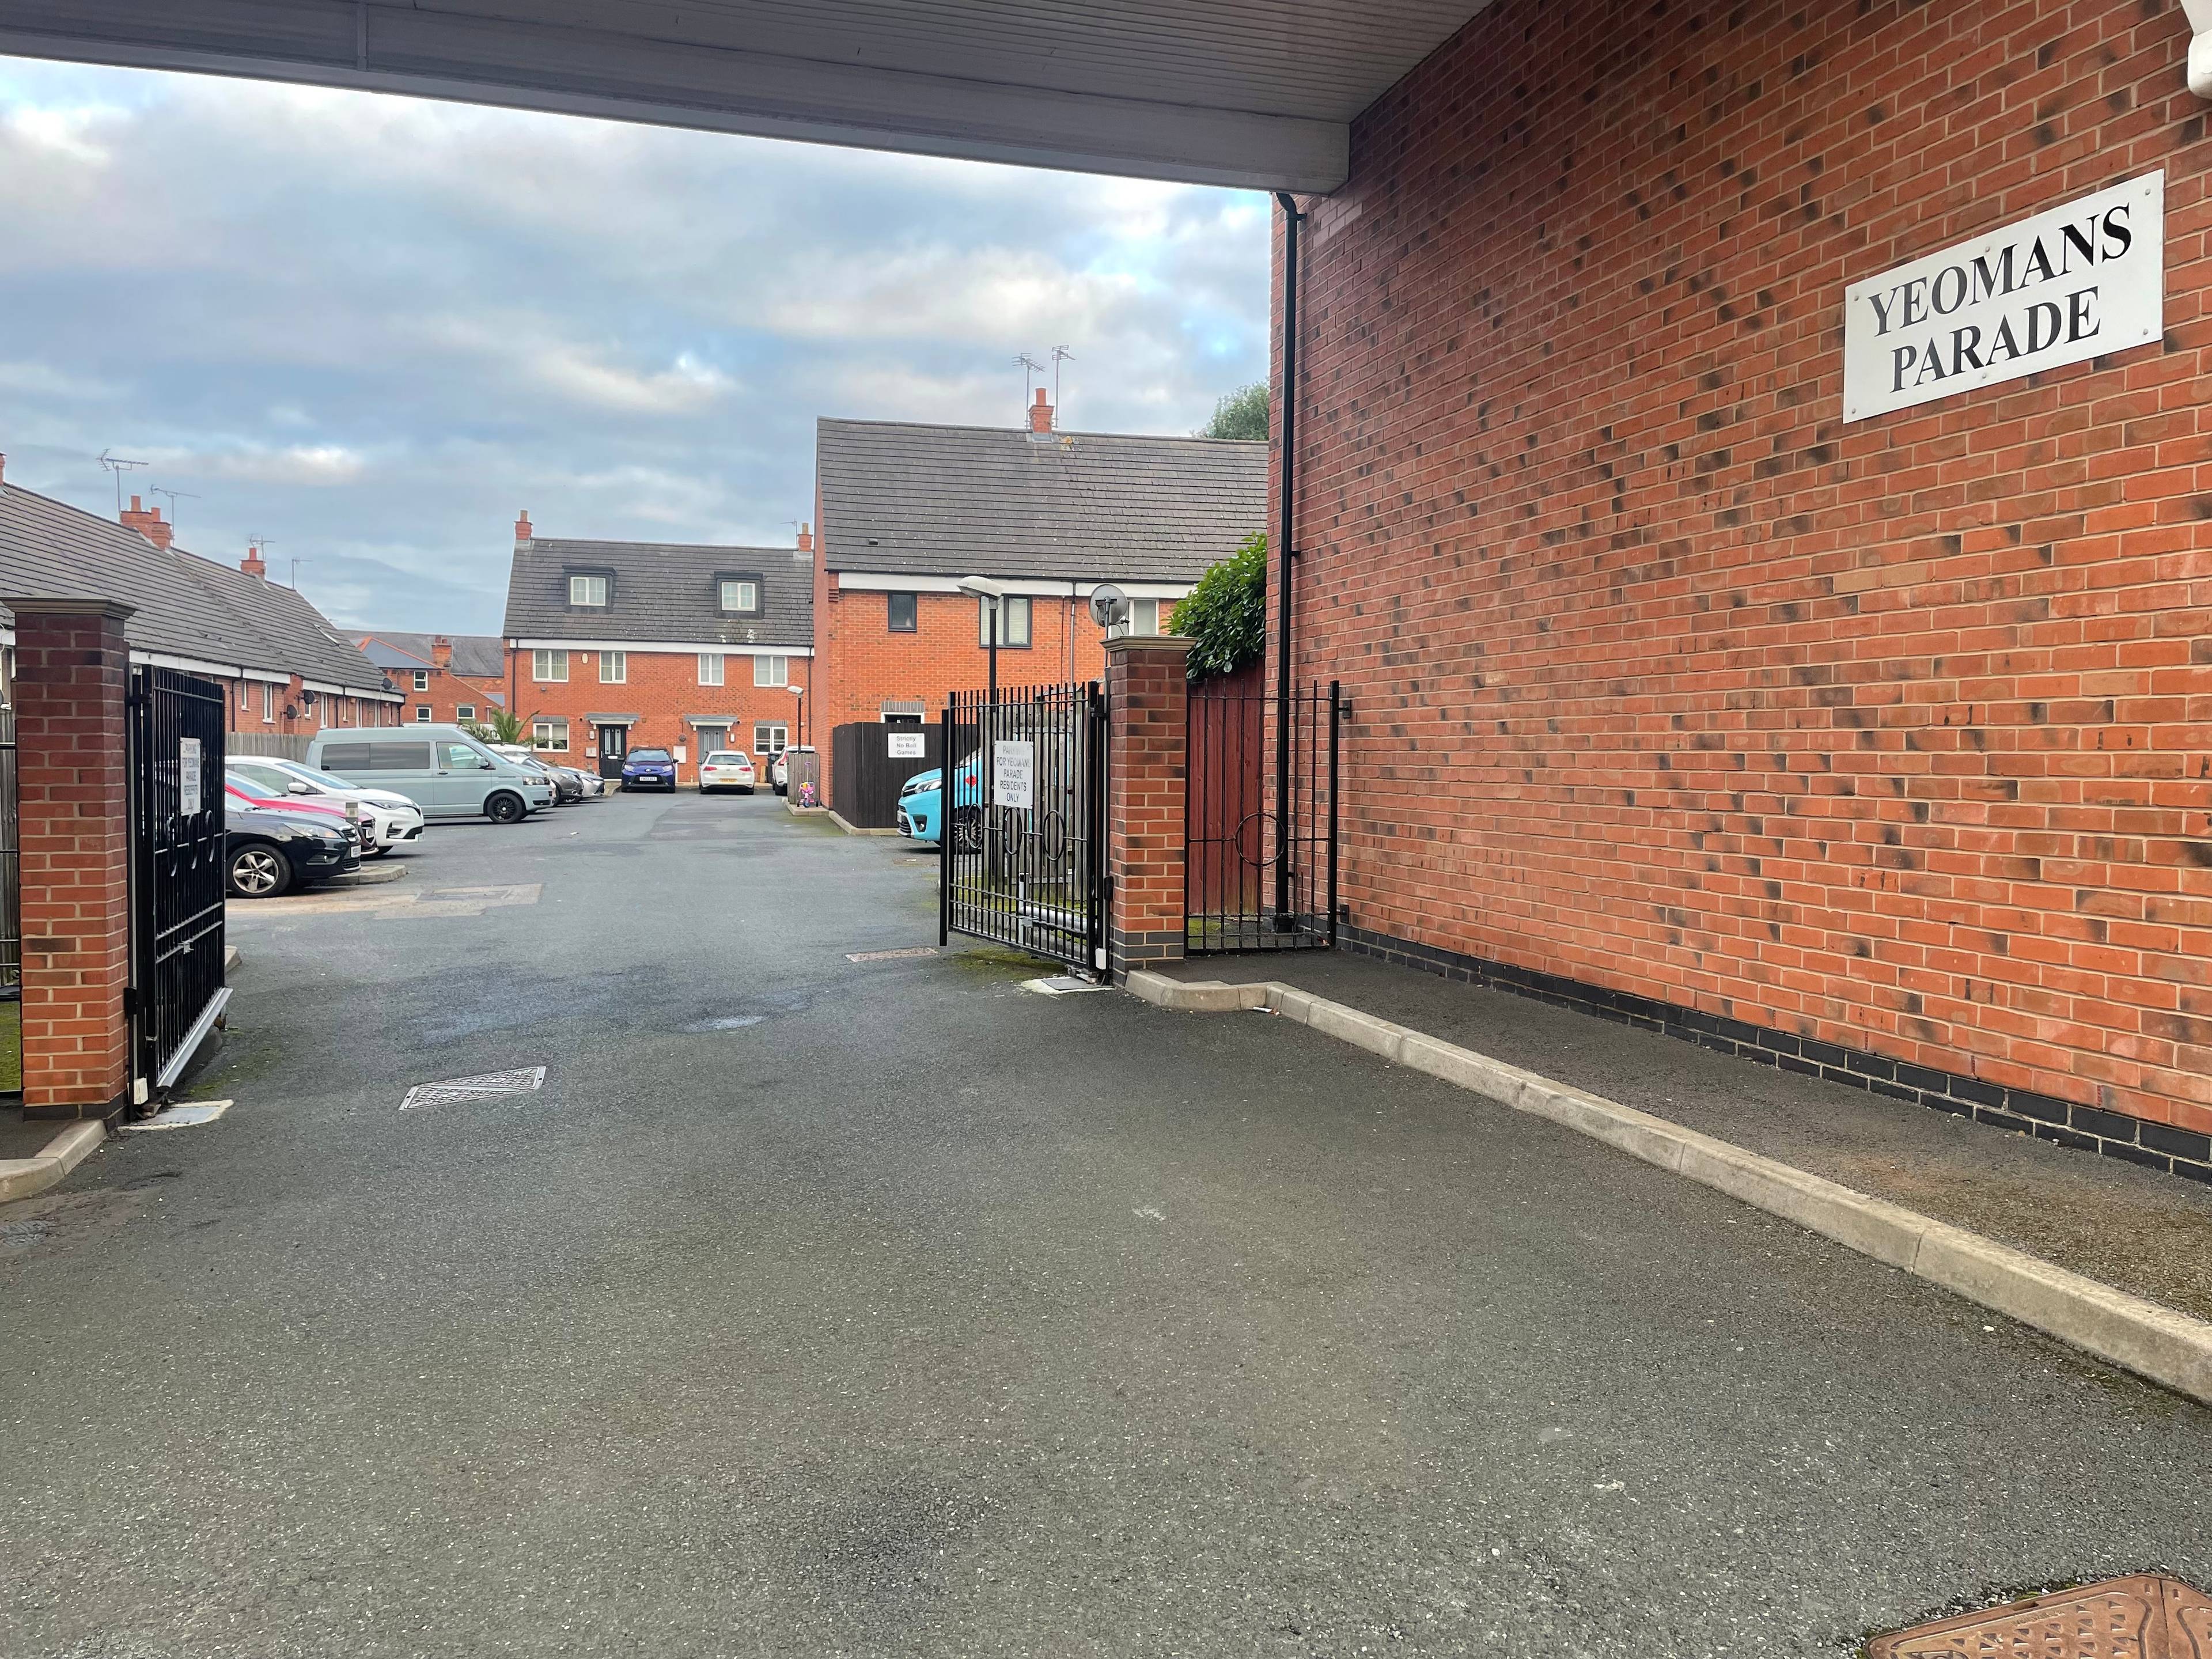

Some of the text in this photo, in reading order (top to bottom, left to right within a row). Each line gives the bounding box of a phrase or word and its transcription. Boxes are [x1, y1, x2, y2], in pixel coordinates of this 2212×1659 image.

[1868, 202, 2132, 338] YEOMANS
[1889, 286, 2100, 394] PARADE
[997, 756, 1006, 766] FOR
[1003, 769, 1023, 779] PARADE
[1000, 780, 1027, 791] RESIDENTS
[1006, 792, 1019, 802] ONLY
